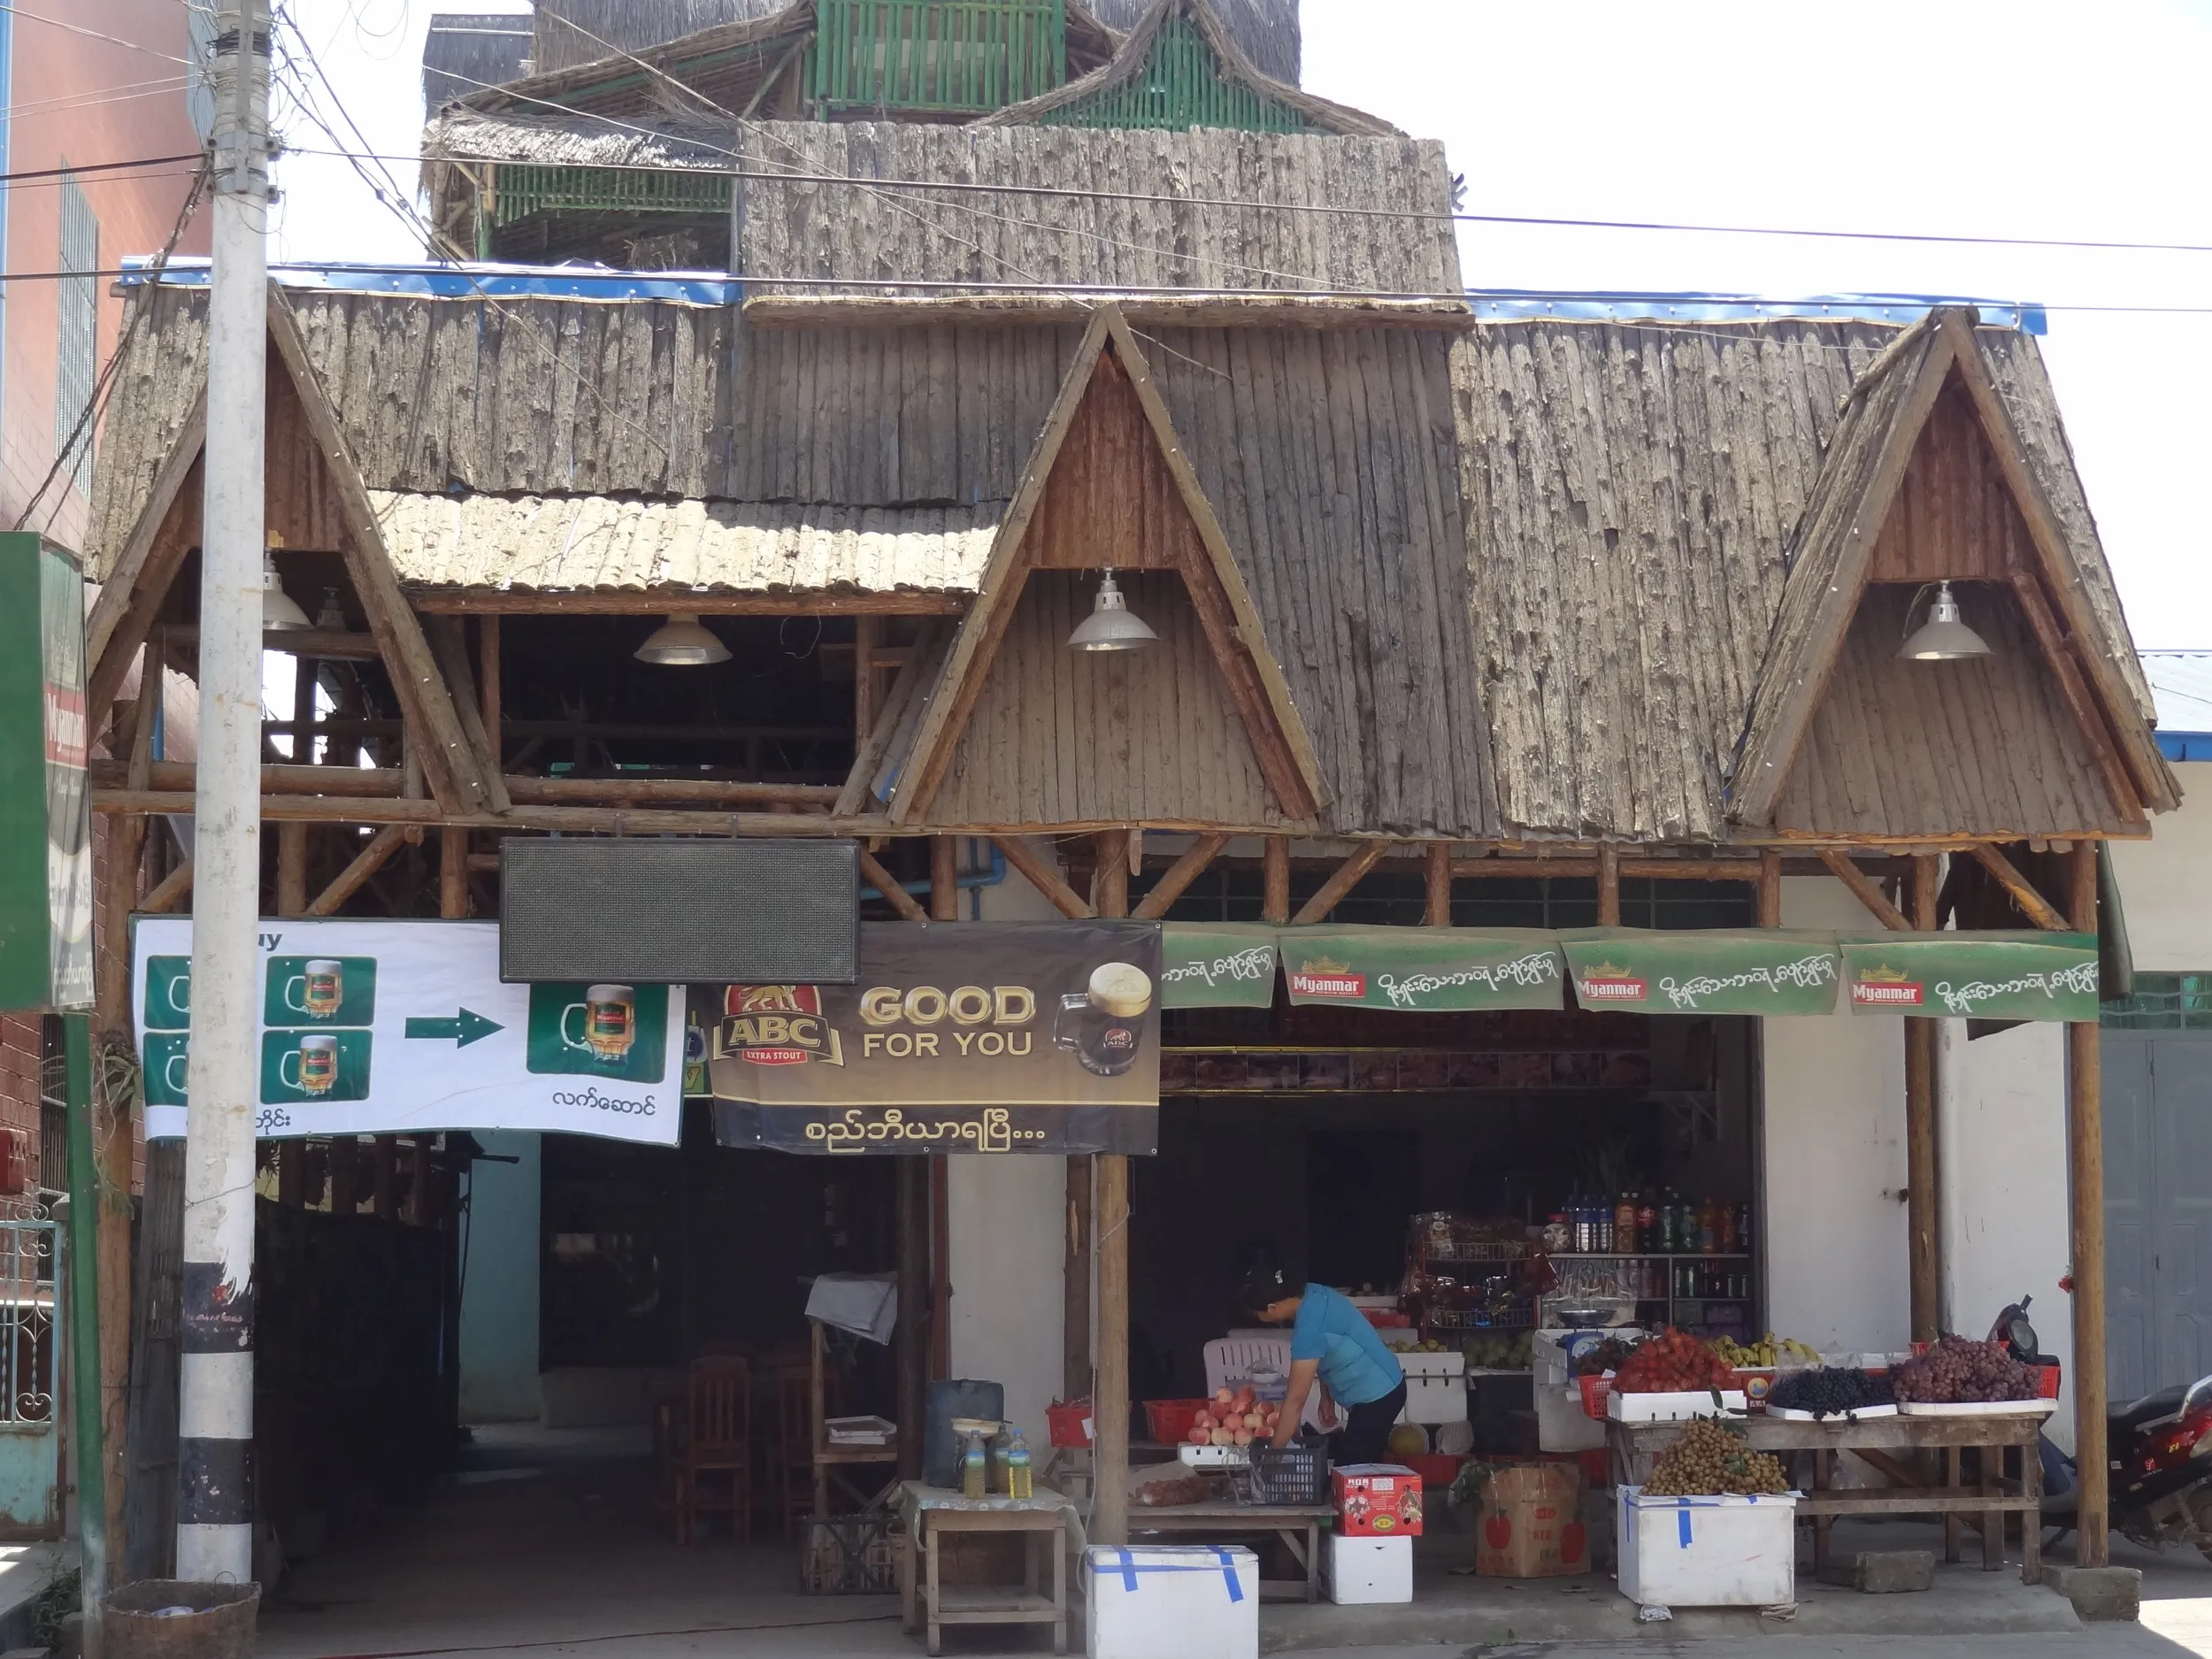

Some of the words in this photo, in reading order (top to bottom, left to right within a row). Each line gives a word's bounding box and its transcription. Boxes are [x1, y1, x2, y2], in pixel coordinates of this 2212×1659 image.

[1293, 975, 1359, 994] Myanmar
[1577, 980, 1641, 997] Myanmar
[1852, 984, 1917, 1002] Myanmar
[859, 986, 1036, 1026] GOOD
[728, 1017, 821, 1048] ABC
[864, 1032, 940, 1057] FOR
[952, 1031, 1033, 1056] YOU
[747, 1050, 772, 1061] EXTRA
[773, 1050, 802, 1060] STOUT
